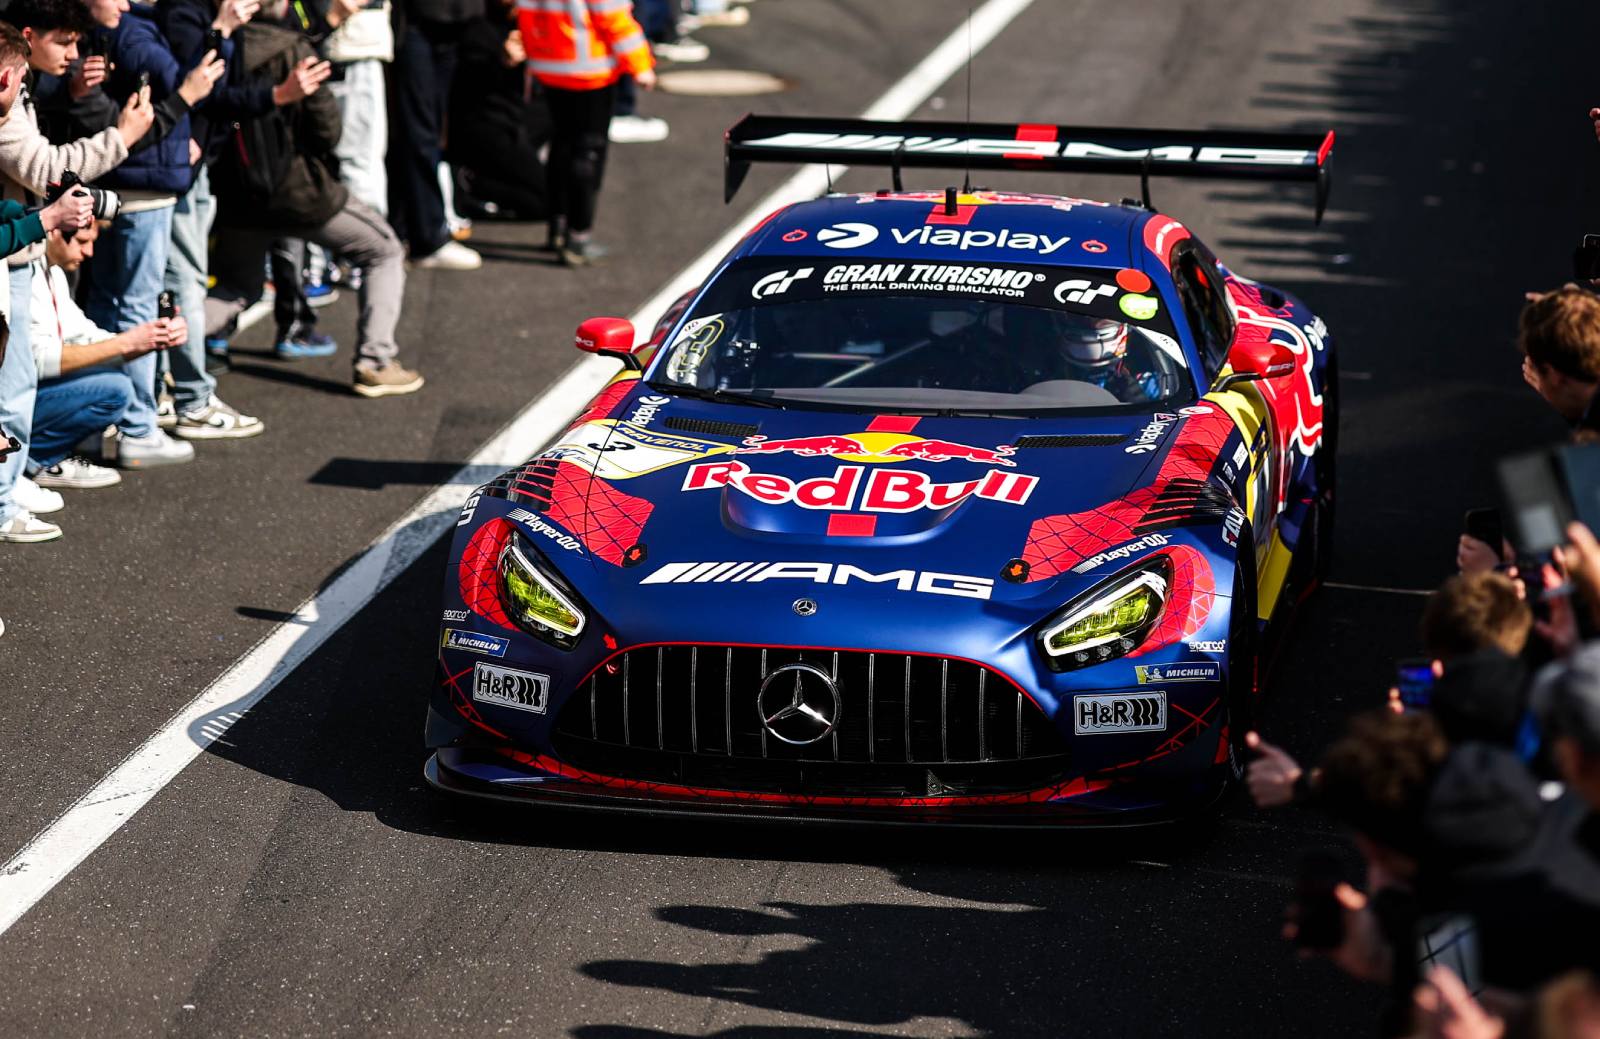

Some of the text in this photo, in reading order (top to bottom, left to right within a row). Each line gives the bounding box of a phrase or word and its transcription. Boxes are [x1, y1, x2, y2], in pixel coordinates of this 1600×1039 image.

[891, 224, 1072, 255] viaplay
[823, 263, 905, 284] GRAN
[823, 282, 1026, 298] THE REAL DRIVING SIMULATOR
[756, 562, 994, 600] AMG
[443, 609, 470, 621] sparco
[457, 636, 501, 652] MICHELIN
[1189, 639, 1226, 651] sparco
[1166, 668, 1215, 678] MICHELIN
[476, 669, 517, 700] H&R
[1079, 699, 1132, 728] H&R
